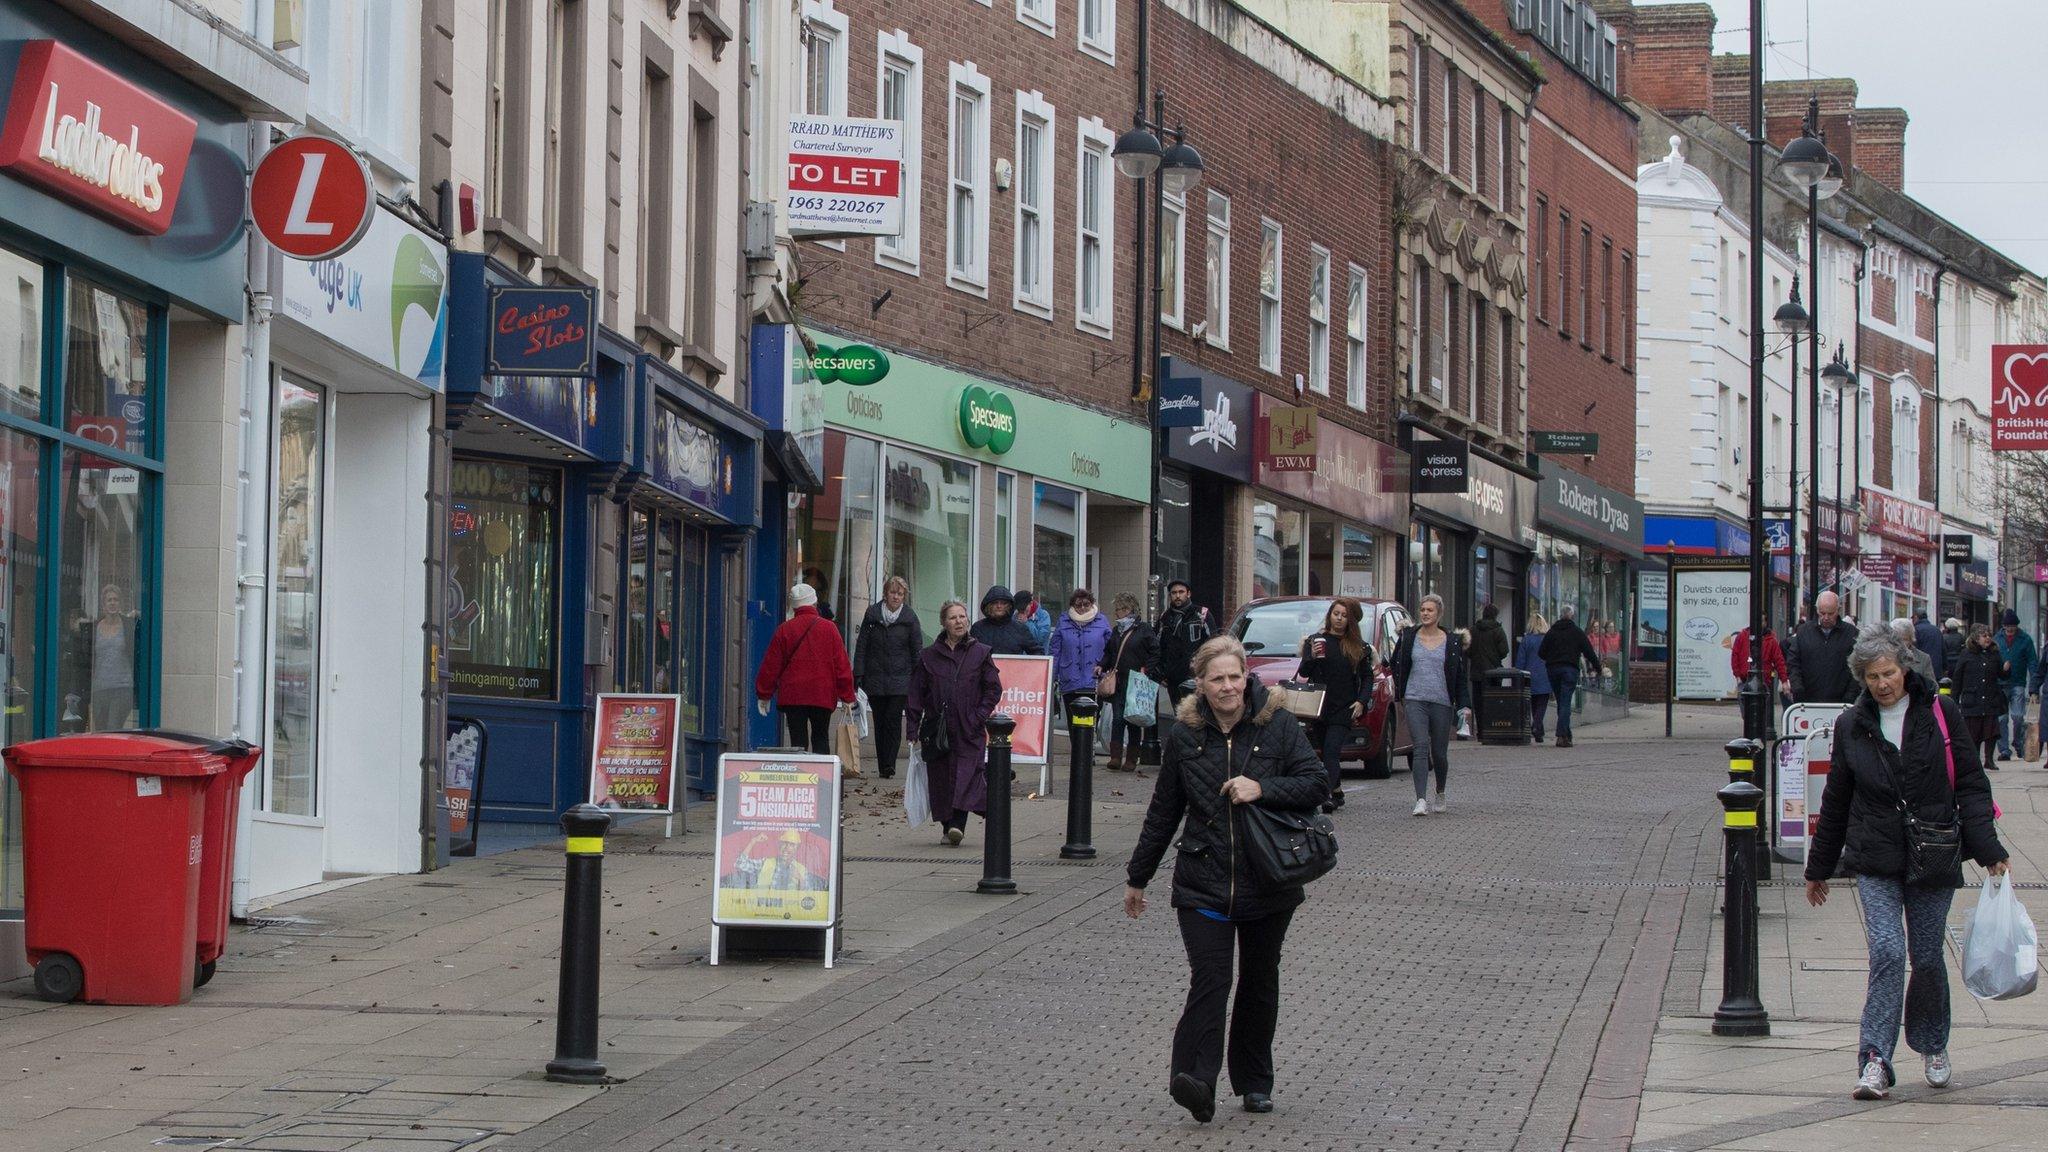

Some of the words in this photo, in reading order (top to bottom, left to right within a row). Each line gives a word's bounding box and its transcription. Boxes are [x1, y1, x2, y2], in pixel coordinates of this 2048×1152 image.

[789, 121, 829, 135] RRARD
[832, 125, 894, 140] MATTHEWS
[38, 81, 164, 213] Ladbrokes
[793, 140, 835, 151] Chartered
[836, 143, 873, 155] Surveyor
[789, 163, 823, 182] TO
[833, 166, 887, 187] LET
[283, 152, 334, 236] L
[828, 199, 885, 214] 220267
[348, 267, 362, 312] UK
[499, 303, 570, 335] Casino
[523, 325, 585, 356] Slots
[814, 357, 876, 370] ecsavers
[848, 391, 883, 421] Opticians
[970, 400, 1013, 433] Specsavers
[1997, 417, 2034, 427] British
[1552, 440, 1581, 448] Dyas
[1071, 451, 1101, 479] Opticians
[1276, 456, 1311, 468] EWM
[1427, 454, 1458, 465] vision
[1420, 467, 1463, 478] express
[1558, 478, 1598, 519] Robert
[1601, 496, 1630, 533] Dyas
[1817, 505, 1853, 537] TIMPON
[1683, 584, 1713, 594] Duvets
[1682, 599, 1698, 607] any
[1700, 596, 1720, 607] size,
[1722, 596, 1739, 606] £10
[995, 703, 1044, 715] uctions
[600, 757, 611, 765] THE
[611, 758, 629, 766] MORE
[629, 758, 641, 766] YOU
[760, 762, 798, 771] Ladbrokes
[617, 767, 634, 775] MORE
[606, 783, 659, 797] £10,000!
[740, 786, 757, 817] 5
[757, 787, 785, 802] TEAM
[787, 788, 815, 803] ACCA
[757, 802, 815, 819] INSURANCE
